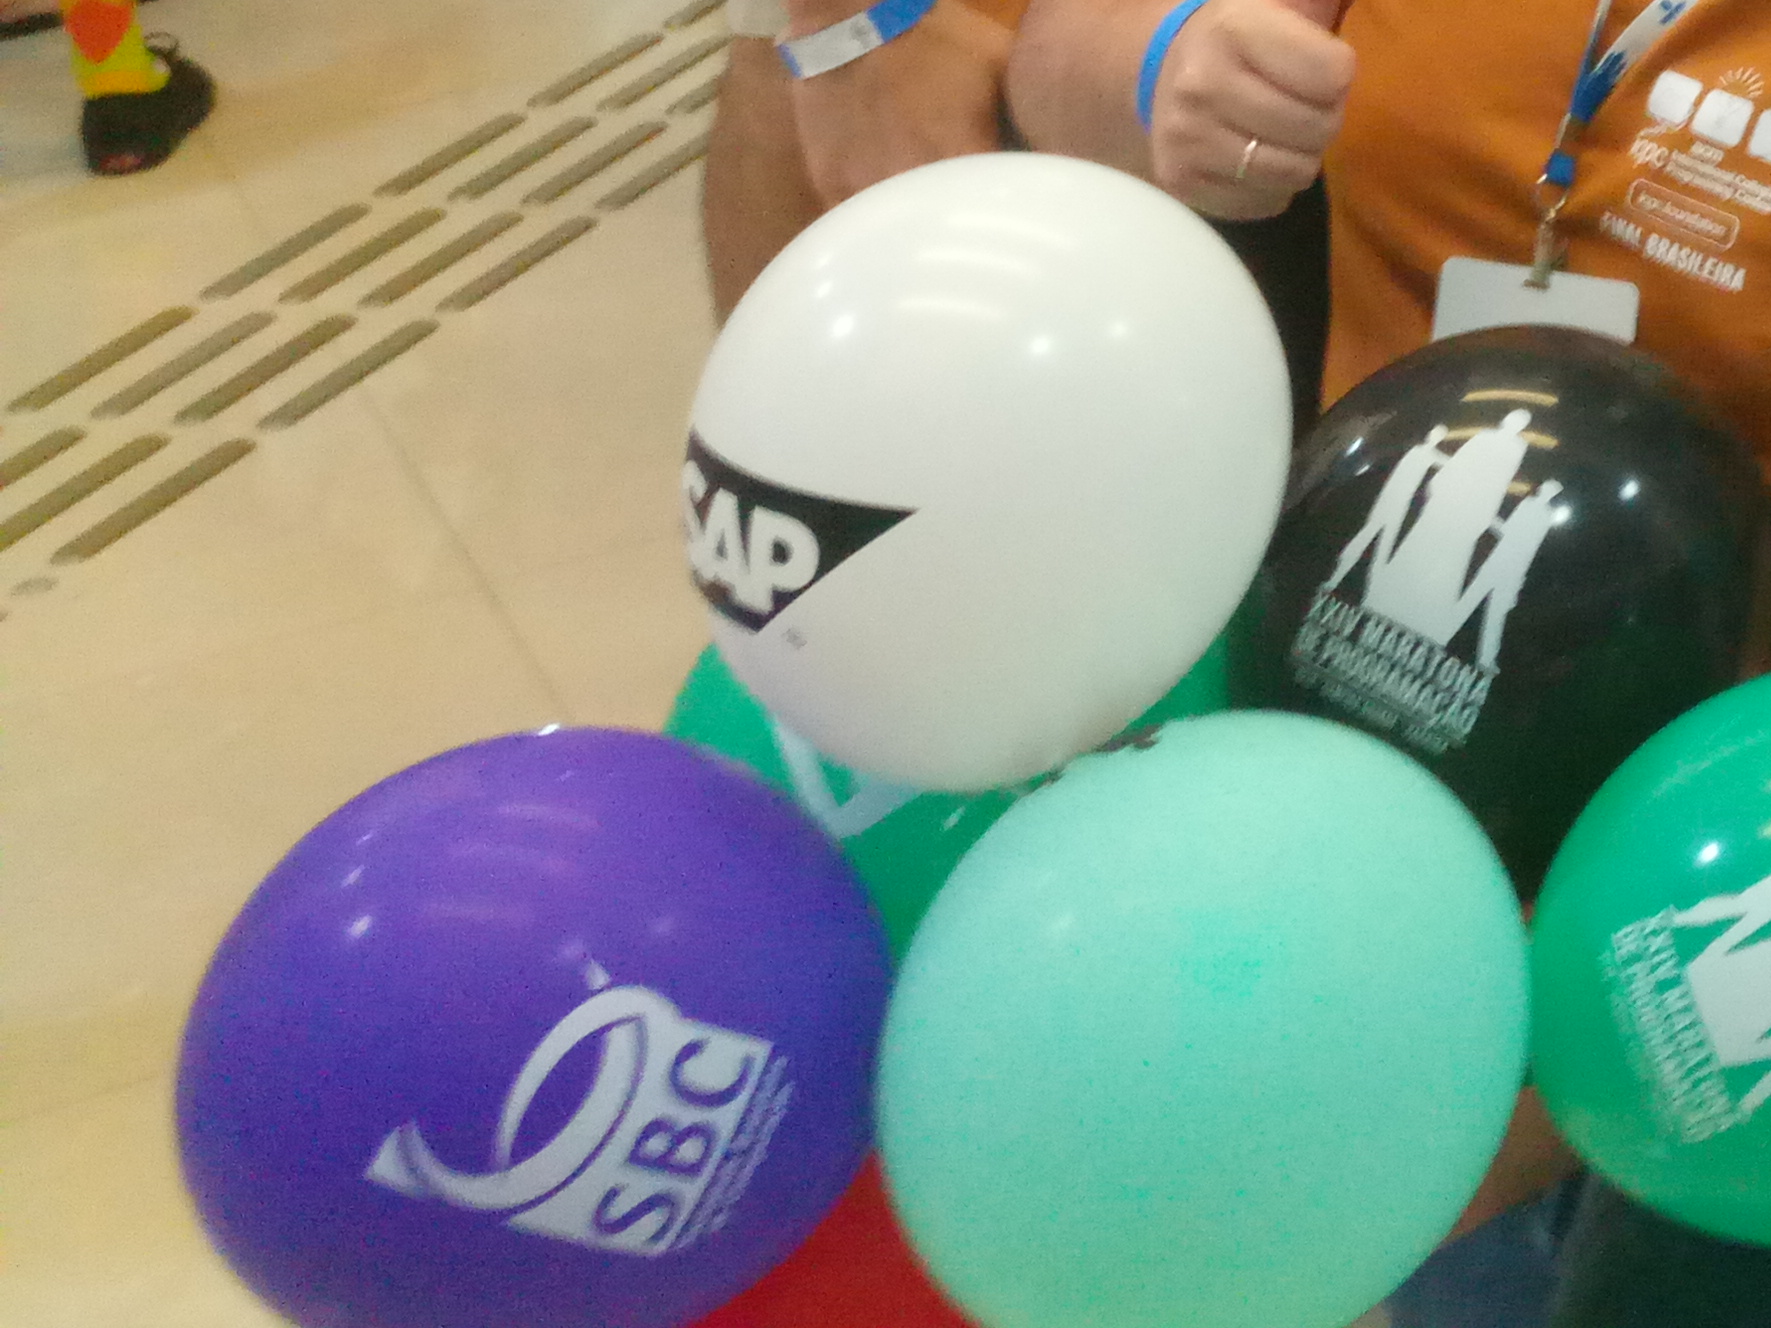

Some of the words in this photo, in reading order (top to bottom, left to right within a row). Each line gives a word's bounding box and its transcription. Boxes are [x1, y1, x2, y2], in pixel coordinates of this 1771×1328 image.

[1600, 210, 1643, 248] FINAL
[1643, 233, 1747, 292] BRASILEIRA
[1356, 616, 1494, 704] MARATONA
[593, 1037, 756, 1243] SBC
